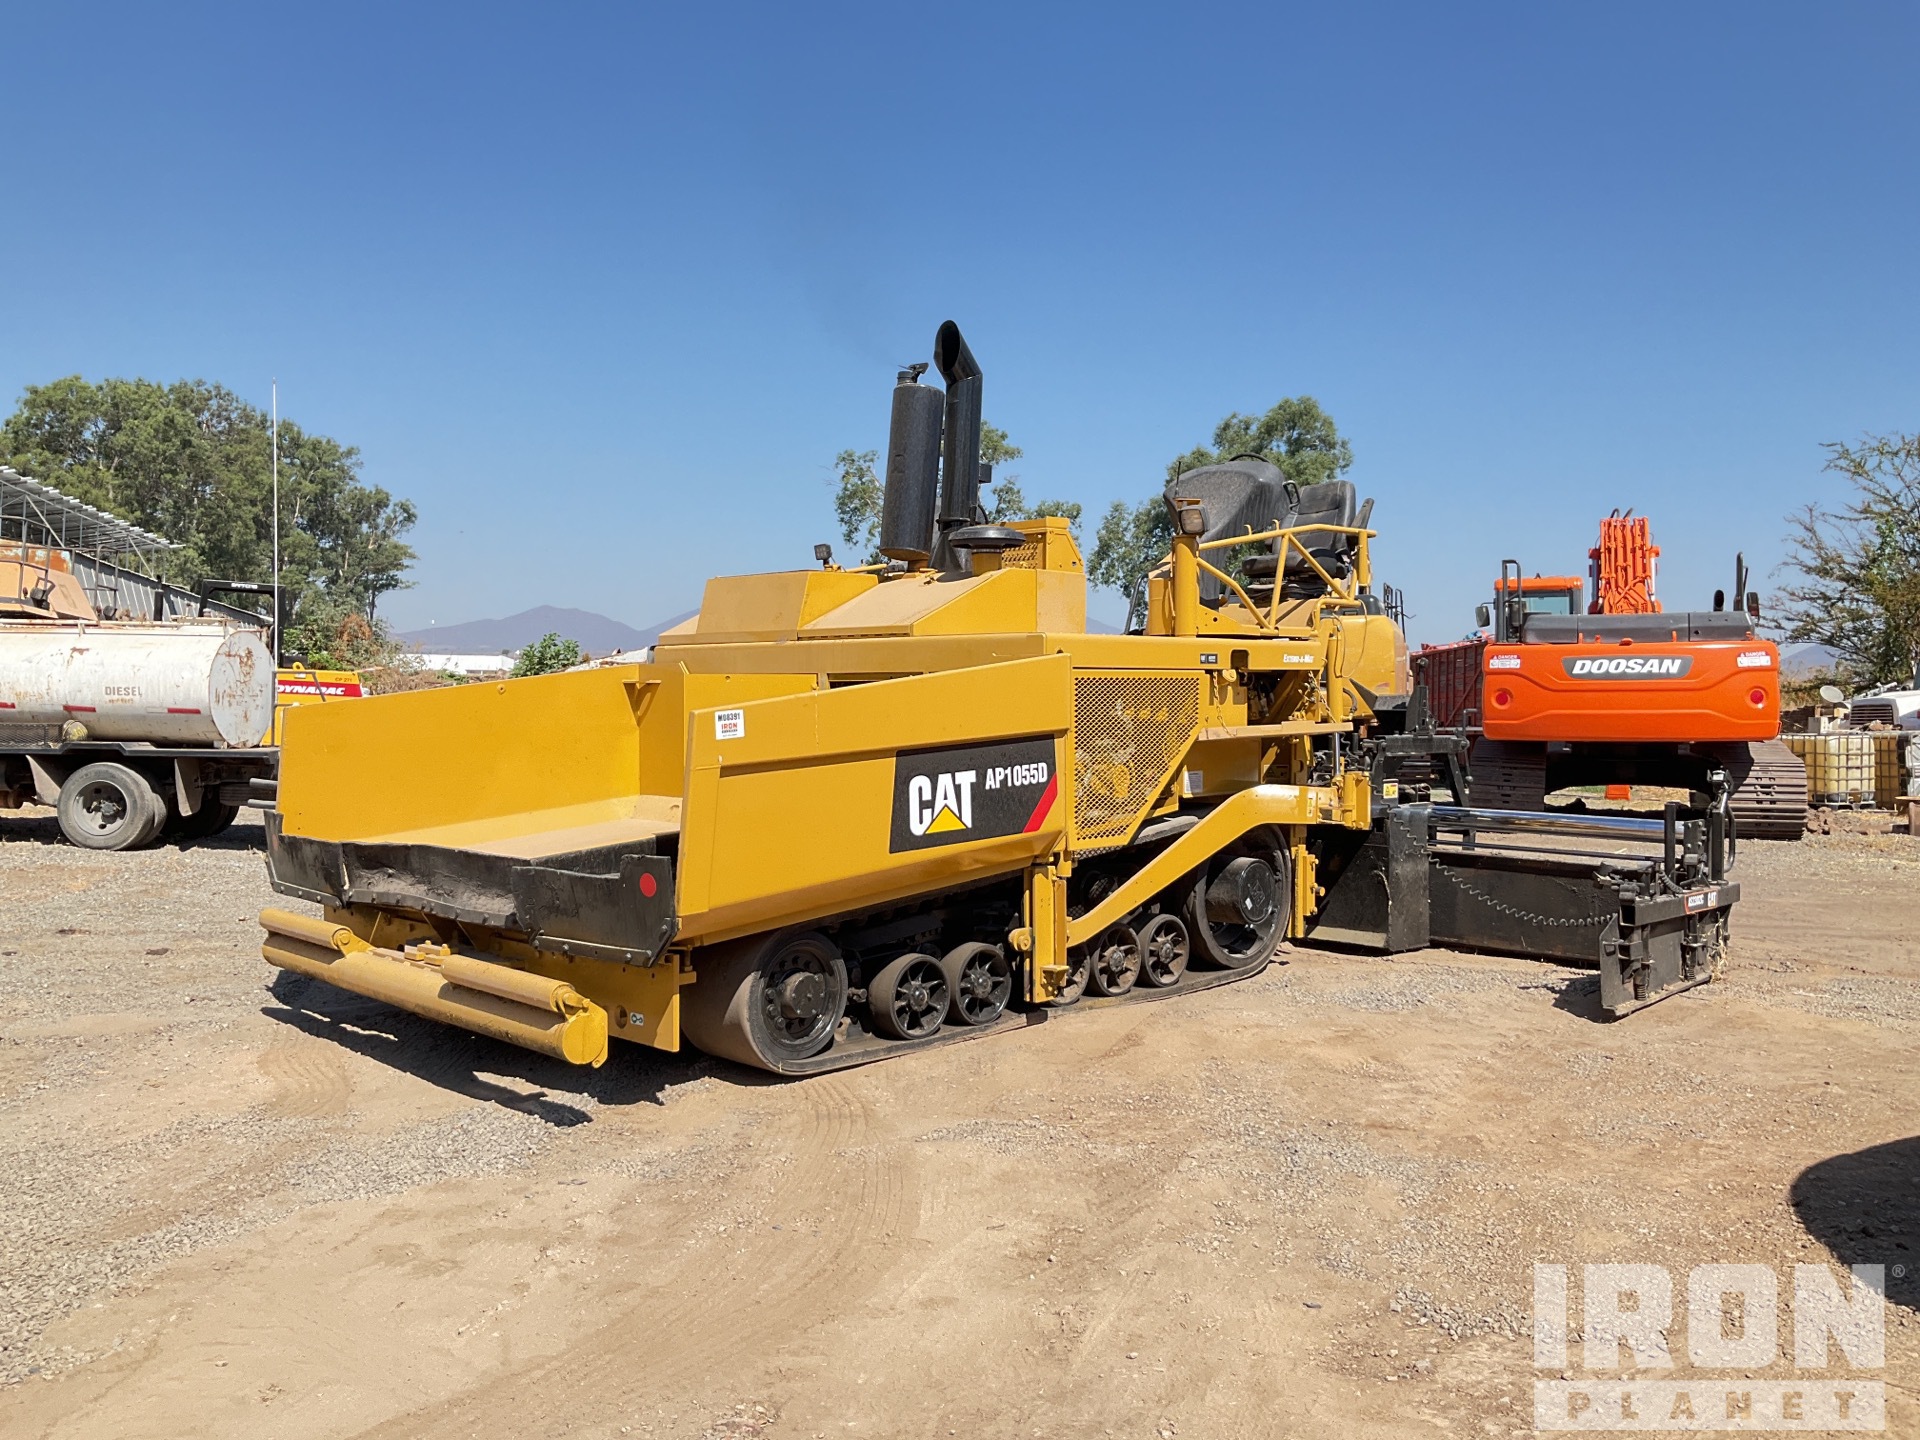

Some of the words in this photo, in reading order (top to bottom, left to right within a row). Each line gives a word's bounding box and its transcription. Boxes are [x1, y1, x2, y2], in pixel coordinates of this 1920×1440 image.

[1572, 659, 1681, 674] DOOSAN
[104, 686, 143, 697] DIESEL
[721, 722, 738, 730] IRON
[908, 770, 977, 836] CAT
[985, 762, 1048, 790] AP1055D
